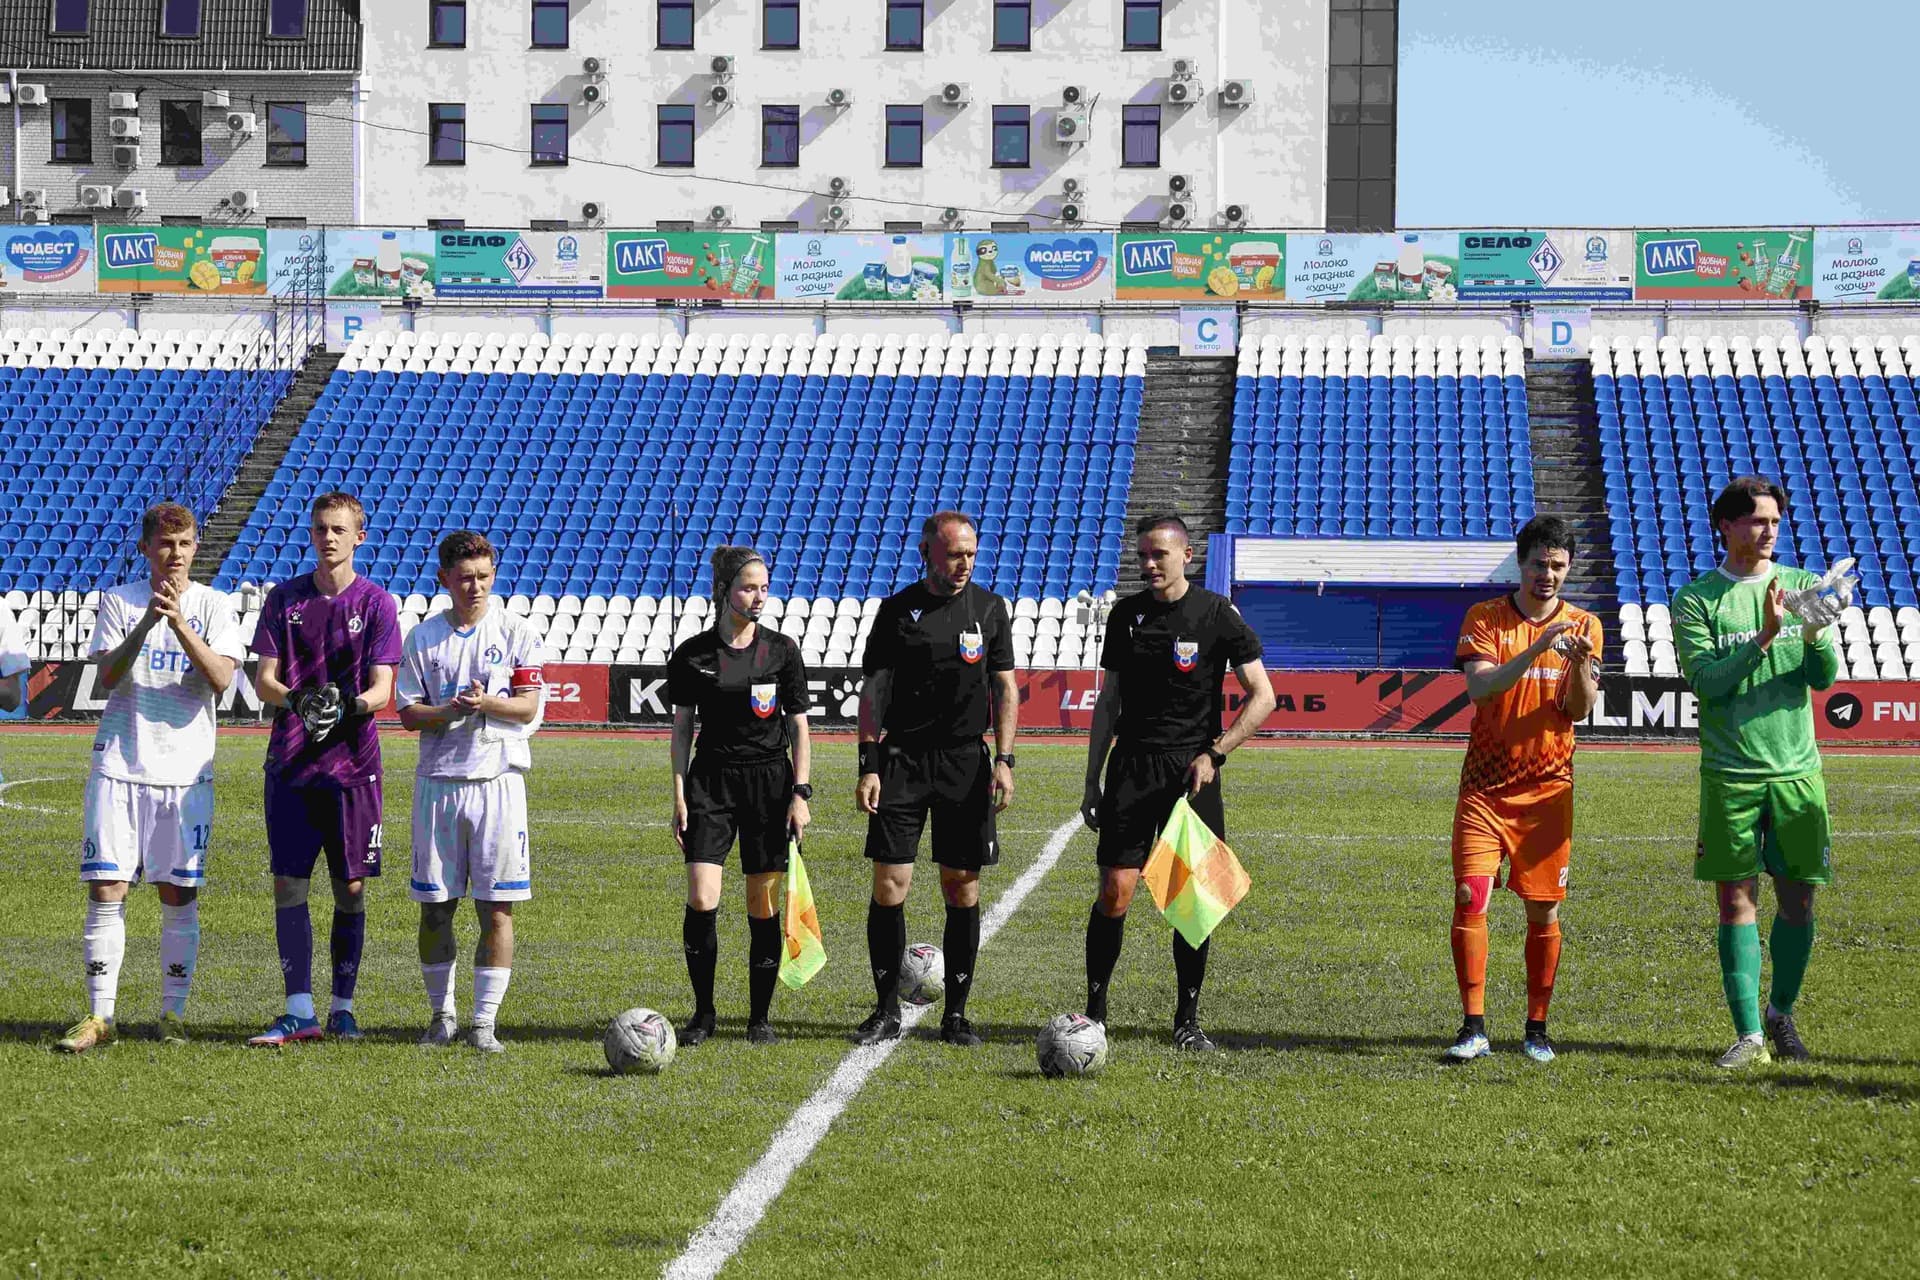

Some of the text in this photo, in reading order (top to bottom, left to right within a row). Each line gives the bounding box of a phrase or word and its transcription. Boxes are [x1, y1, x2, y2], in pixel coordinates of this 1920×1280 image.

[441, 235, 506, 247] СЕЛФ
[1464, 237, 1532, 248] СЕЛФ
[11, 243, 74, 255] МОДЕСТ
[111, 238, 155, 261] ЛАКТ
[157, 250, 184, 260] УДОБНАЯ
[622, 244, 666, 268] ЛАКТ
[666, 255, 694, 266] УДОБНАЯ
[1030, 250, 1093, 263] МОДЕСТ
[1129, 245, 1173, 269] ЛАКТ
[1651, 245, 1697, 269] ЛАКТ
[1697, 255, 1727, 266] УДОБНАЯ
[1832, 257, 1878, 269] Молоко
[792, 259, 836, 270] Молоко
[1303, 258, 1348, 270] Молоко
[1697, 265, 1722, 275] ПОЛЬЗА
[784, 270, 843, 284] на разные
[1294, 270, 1355, 284] на разные
[1822, 268, 1886, 284] на разные
[1197, 317, 1218, 343] C
[1552, 321, 1573, 345] D
[1873, 701, 1920, 721] FN
[193, 824, 210, 850] 12
[518, 831, 526, 858] 7
